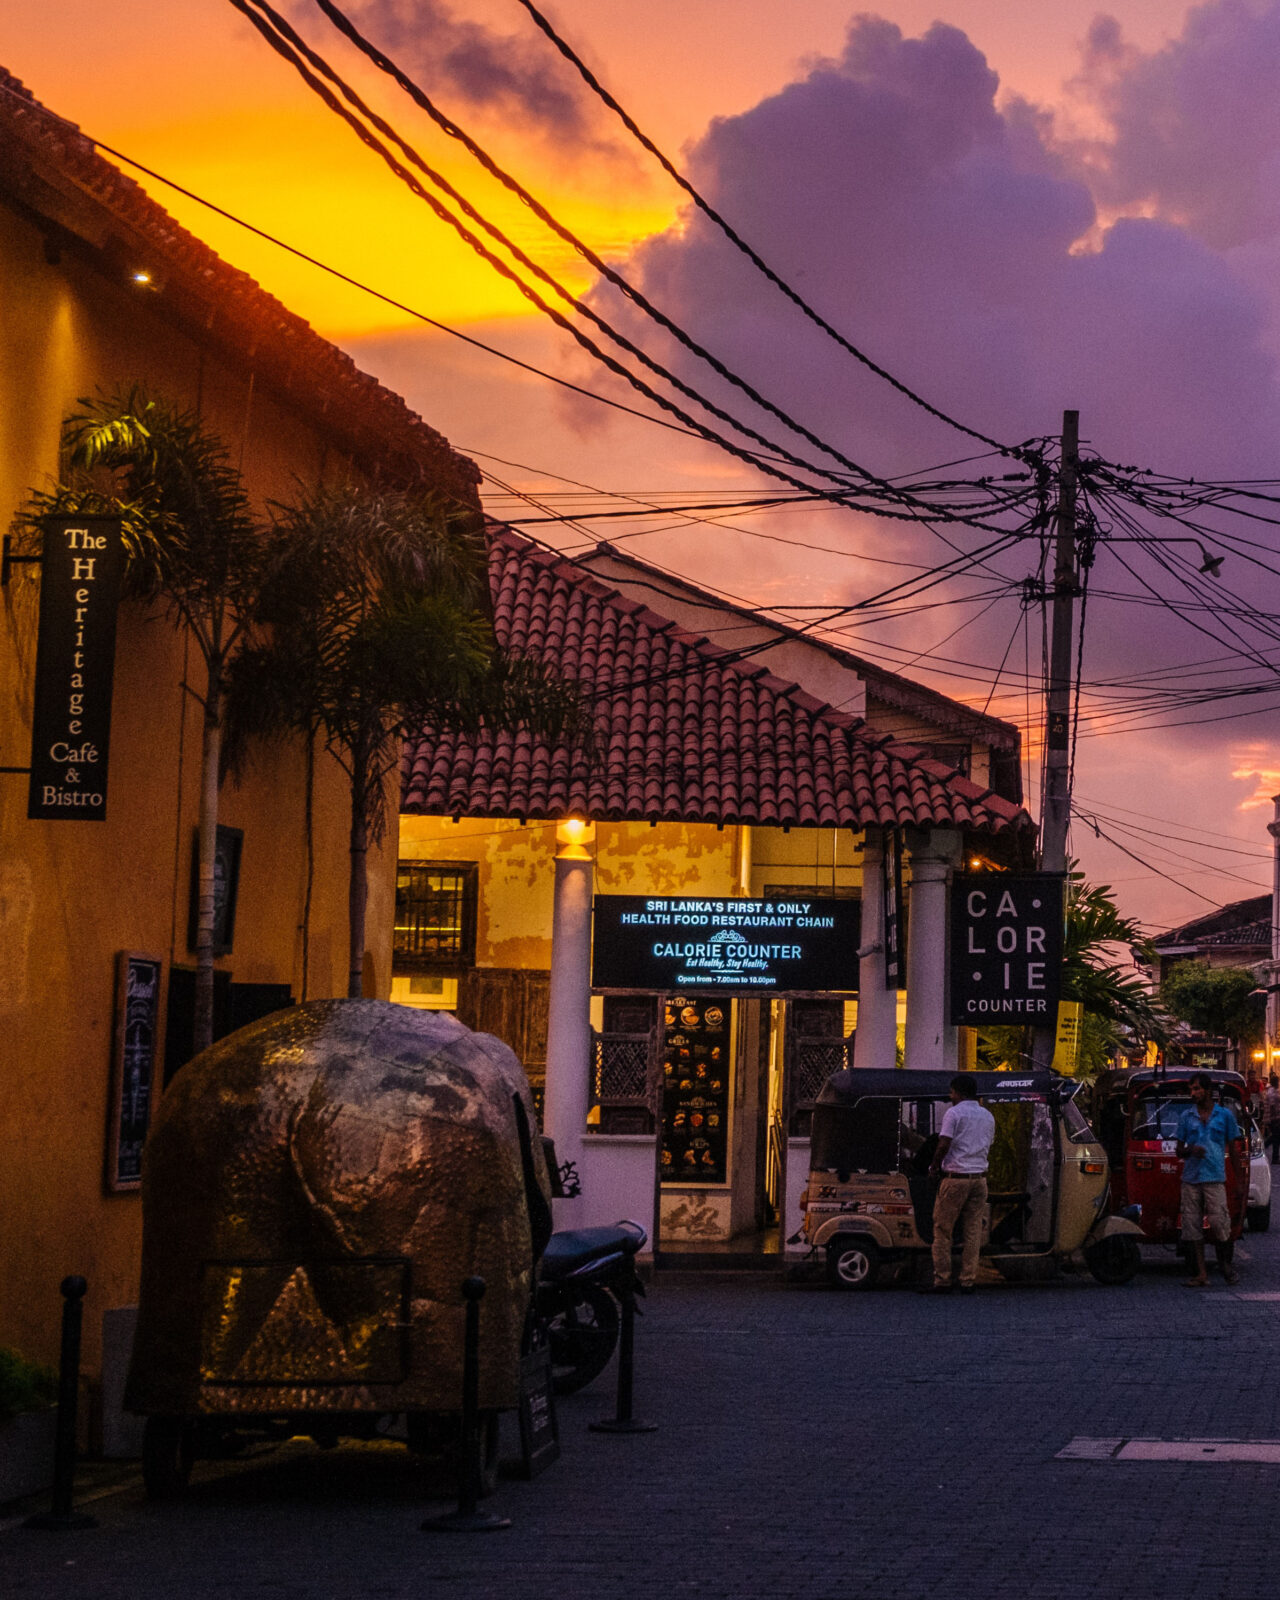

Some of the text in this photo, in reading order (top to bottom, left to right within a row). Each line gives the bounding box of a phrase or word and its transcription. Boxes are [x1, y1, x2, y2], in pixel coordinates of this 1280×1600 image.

[64, 528, 108, 550] The
[68, 557, 97, 735] Heritage
[50, 742, 99, 763] Café
[65, 767, 81, 783] &
[41, 785, 103, 807] Bistro
[647, 901, 811, 914] SRI LANKA'S FIRST & ONLY
[622, 913, 835, 927] HEALTH FOOD RESTAURANT CHAIN
[653, 943, 802, 959] CALORIE COUNTER
[686, 958, 698, 967] Eat
[726, 959, 742, 969] Stay
[677, 975, 696, 984] Open
[697, 975, 713, 983] from
[966, 999, 1047, 1012] COUNTER
